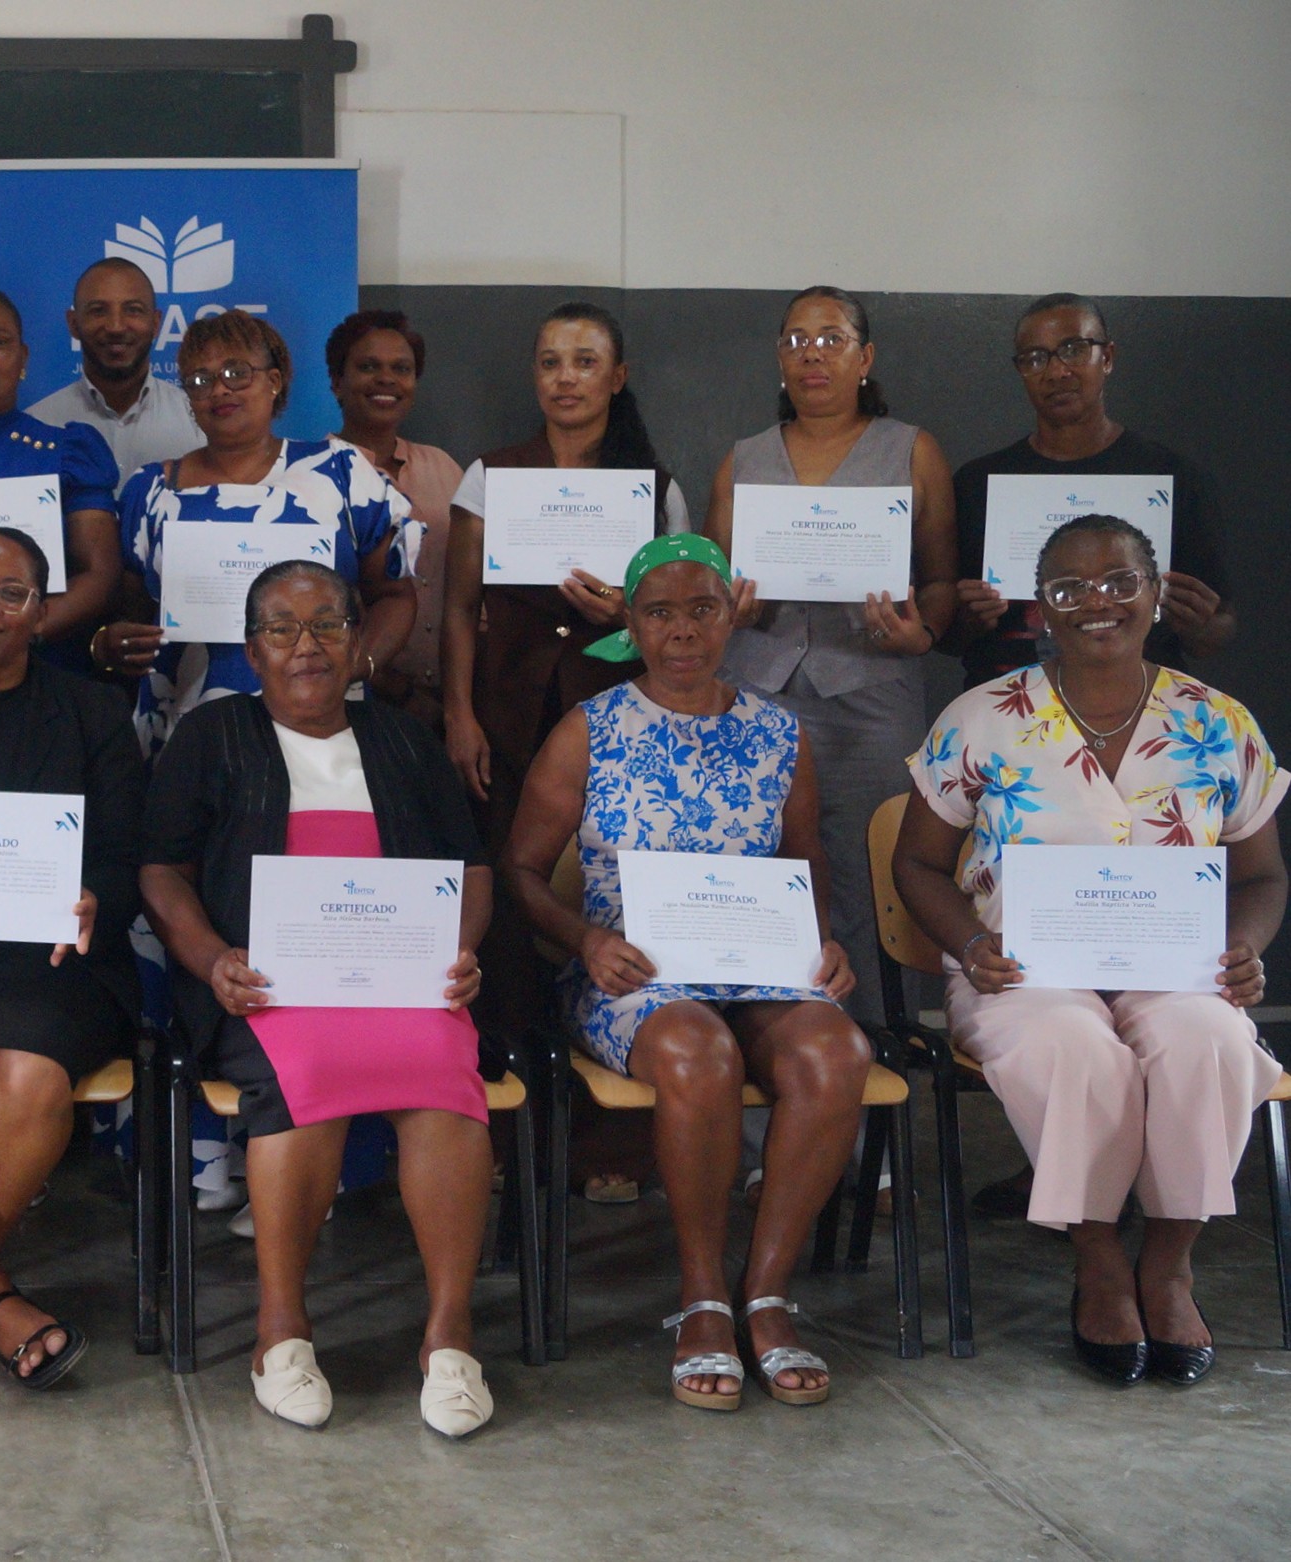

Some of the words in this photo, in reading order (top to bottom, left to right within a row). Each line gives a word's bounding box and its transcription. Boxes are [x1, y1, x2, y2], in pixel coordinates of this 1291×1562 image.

[540, 504, 603, 513] CERTIFICADO
[791, 521, 857, 530] CERTIFICADO
[219, 560, 280, 569] CERTIFICAD
[687, 892, 758, 905] CERTIFICADO
[1075, 889, 1157, 900] CERTIFICADO
[320, 903, 398, 914] CERTIFICADO
